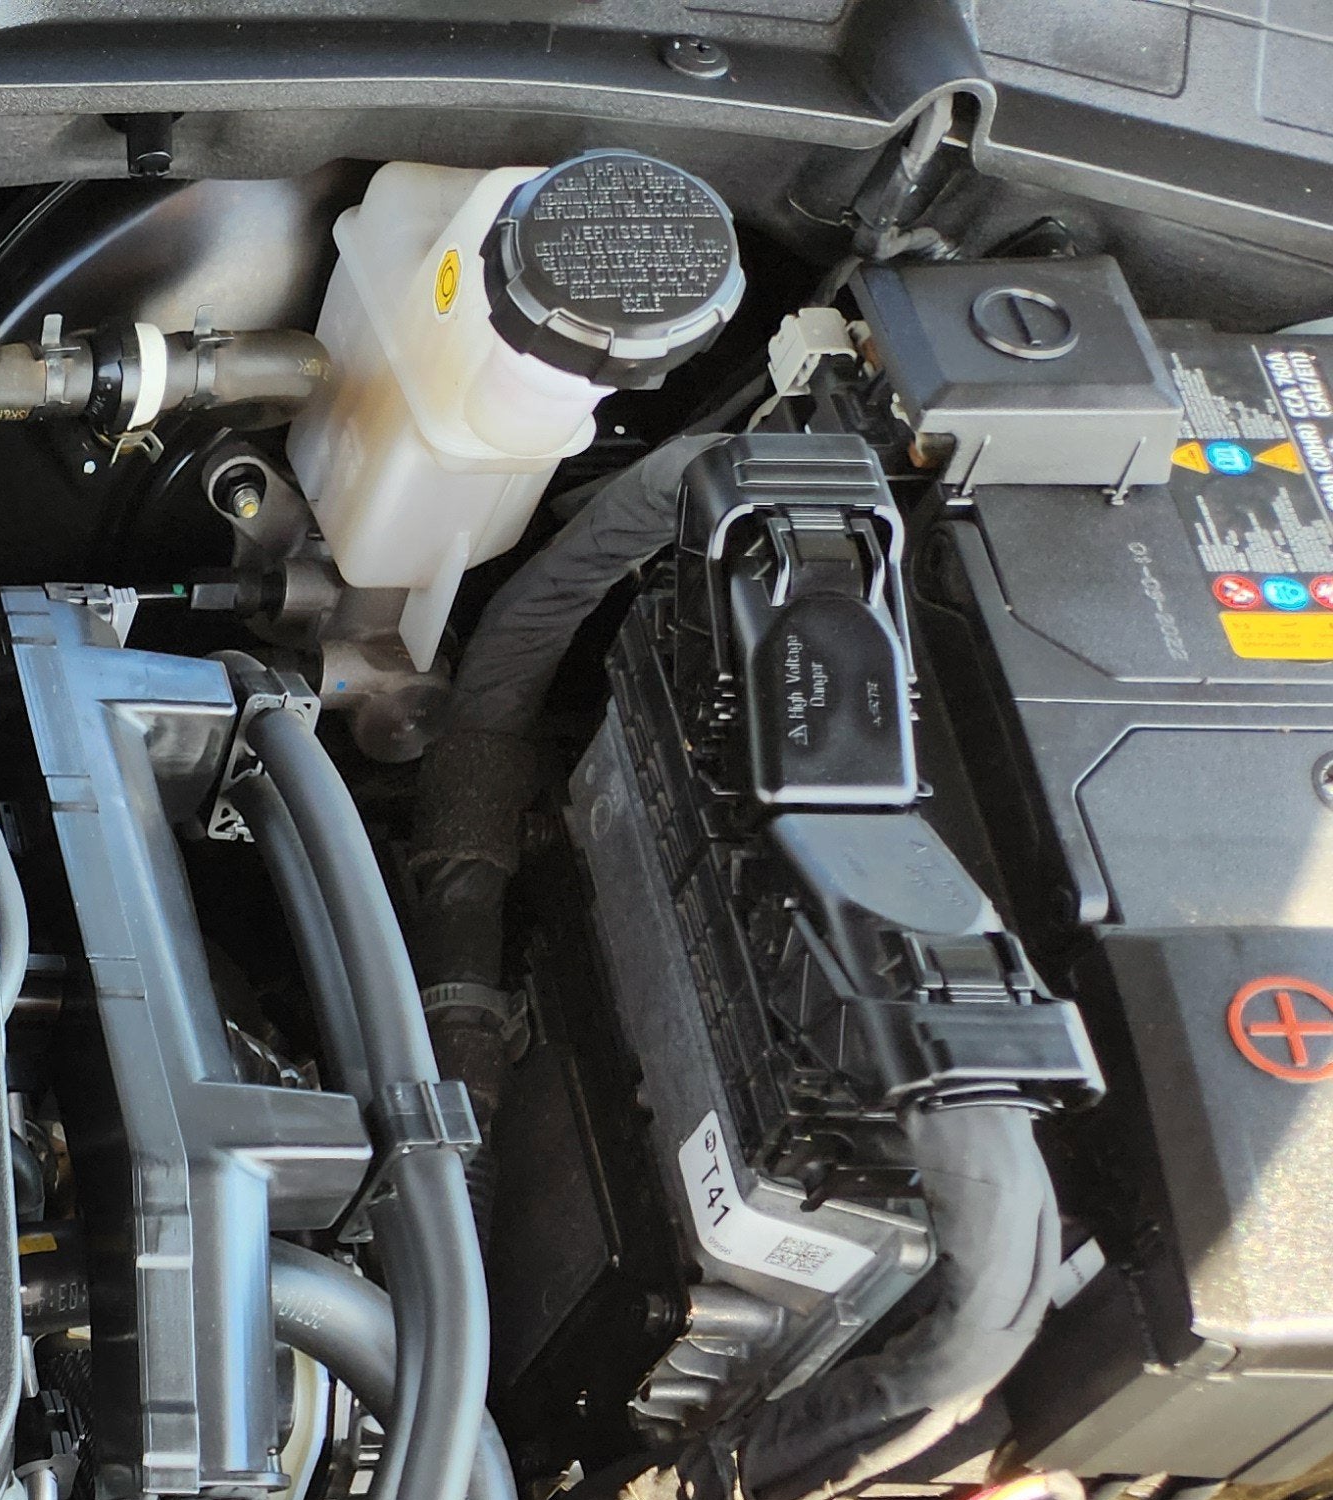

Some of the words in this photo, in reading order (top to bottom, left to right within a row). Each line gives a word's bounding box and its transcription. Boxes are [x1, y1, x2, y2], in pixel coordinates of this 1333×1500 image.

[561, 225, 695, 241] AVERTISSEMENT
[784, 634, 804, 684] Voltage
[787, 691, 808, 719] High
[809, 660, 829, 707] Danger
[701, 1153, 731, 1228] T41
